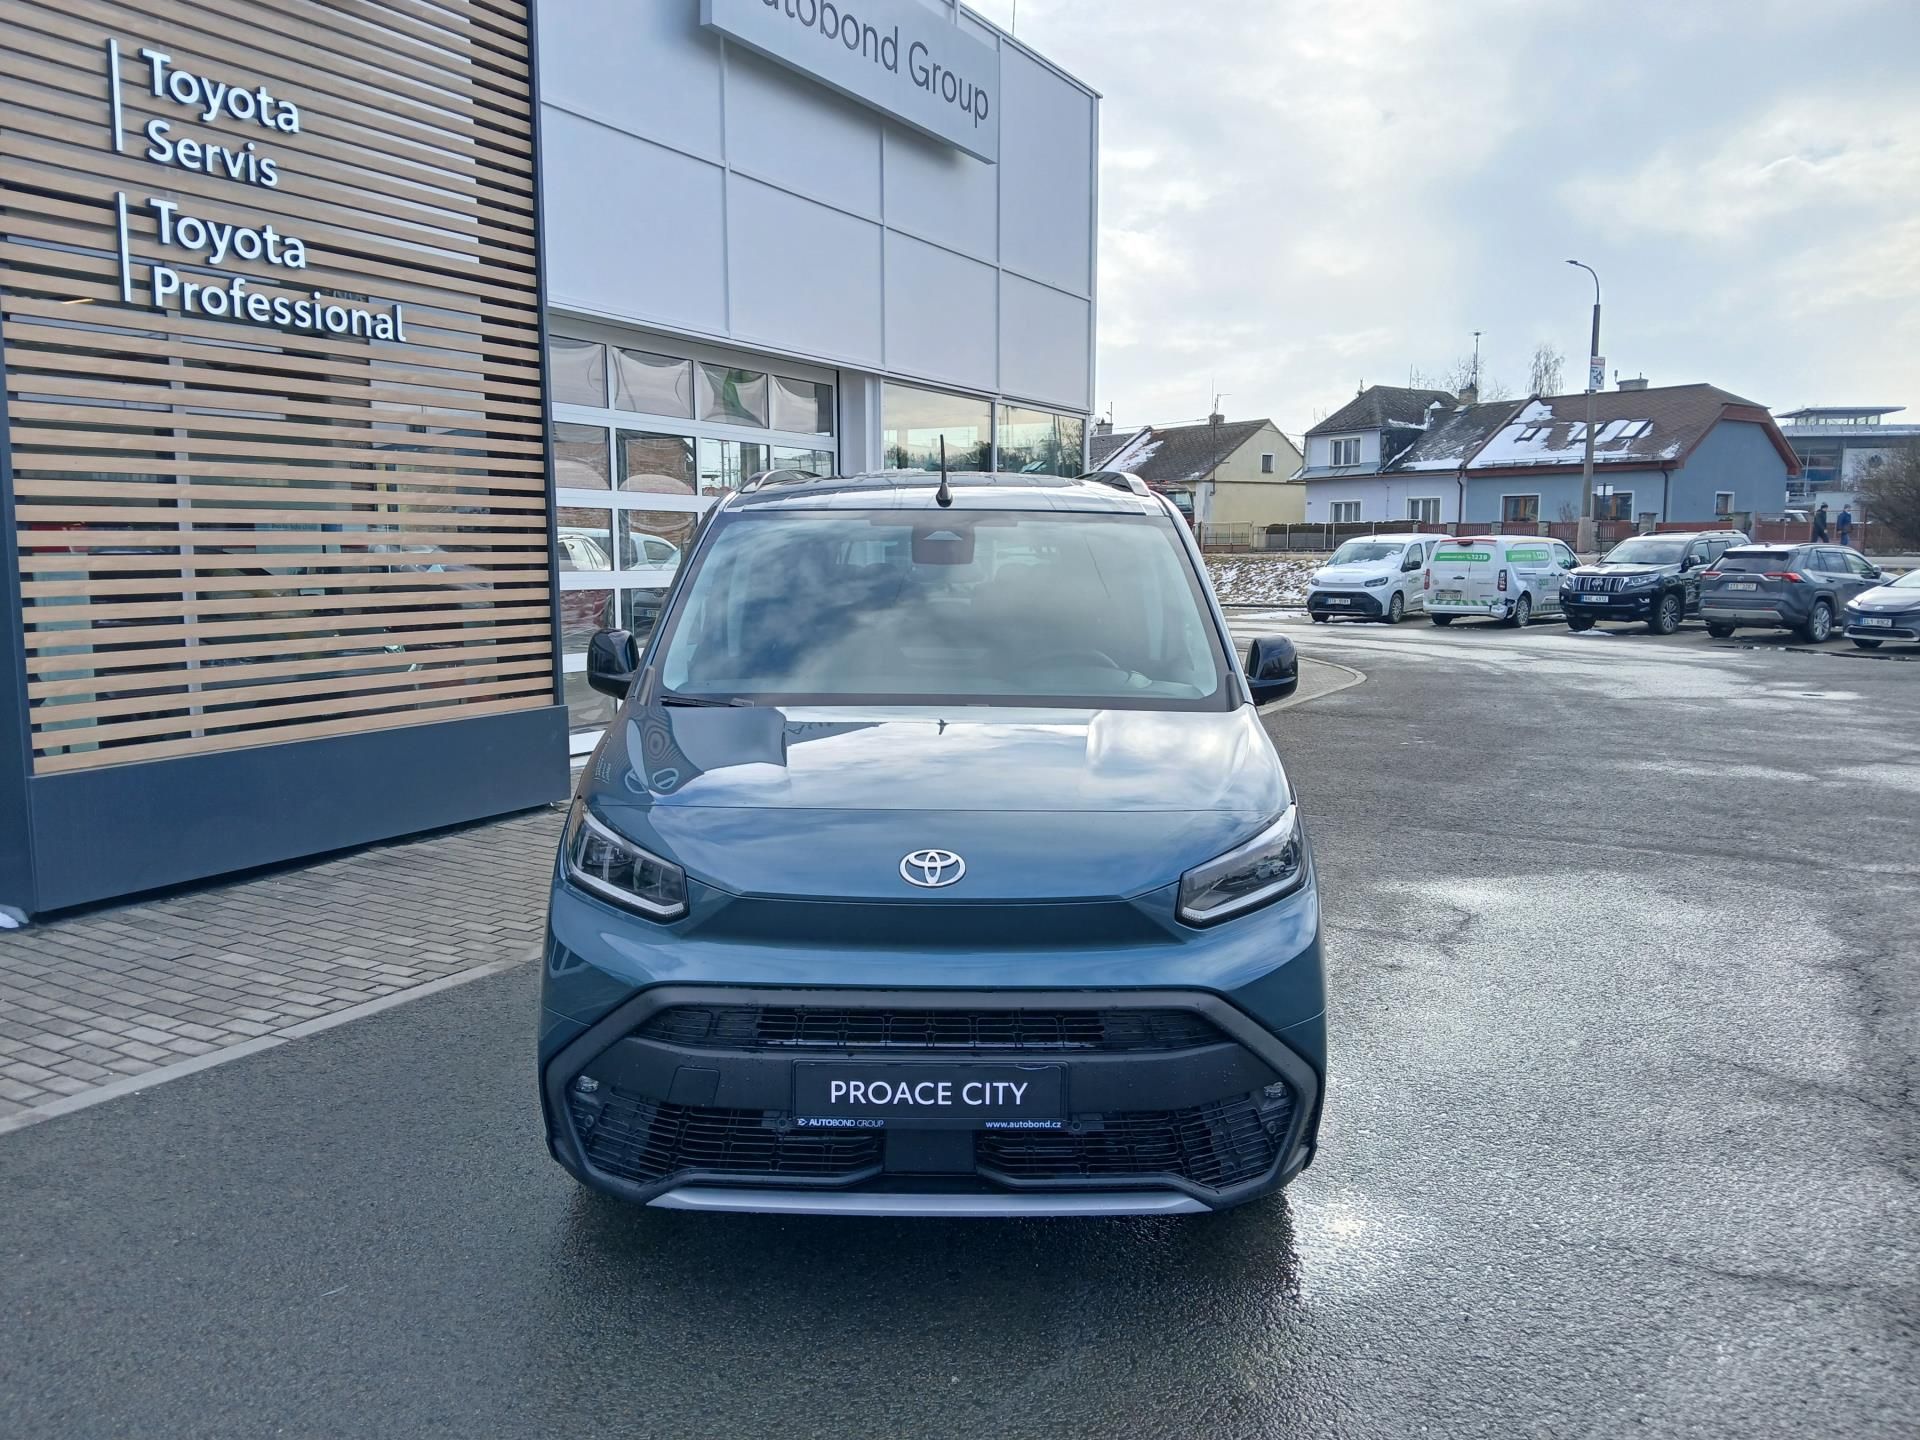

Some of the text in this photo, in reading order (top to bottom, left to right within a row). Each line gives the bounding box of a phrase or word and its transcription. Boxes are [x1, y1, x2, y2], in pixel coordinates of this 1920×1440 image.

[140, 48, 300, 134] Toyota
[762, 0, 989, 128] obond Group
[146, 119, 279, 187] Servis
[150, 198, 307, 269] Toyota
[153, 266, 407, 342] Professional
[808, 1118, 885, 1128] AUTOBOND GROUP
[830, 1080, 1029, 1105] PROACE CITY
[985, 1119, 1062, 1129] www.autobond.cz
